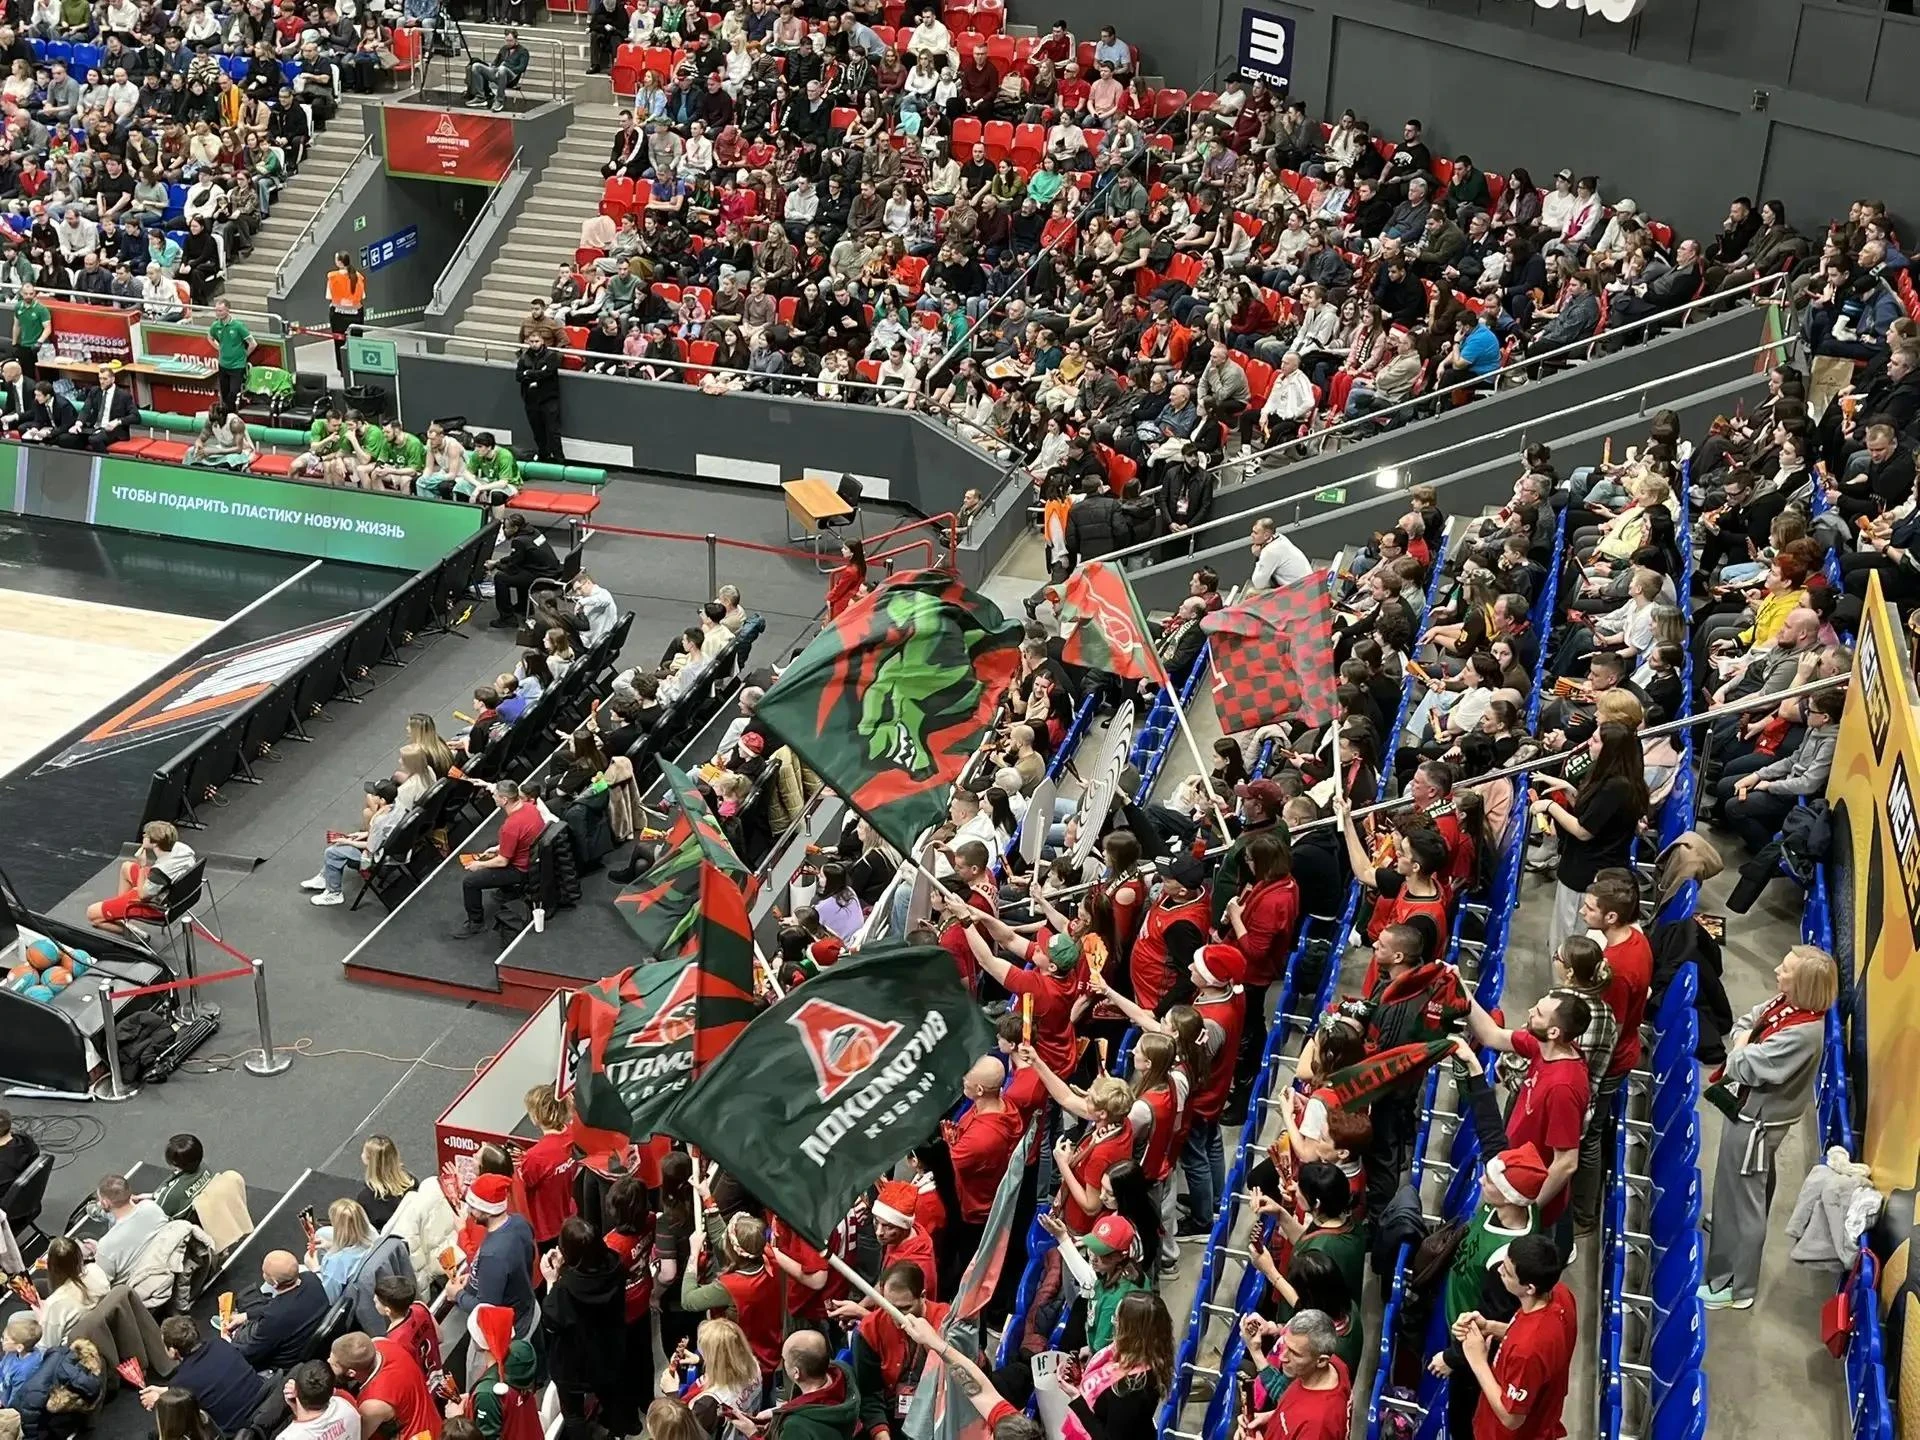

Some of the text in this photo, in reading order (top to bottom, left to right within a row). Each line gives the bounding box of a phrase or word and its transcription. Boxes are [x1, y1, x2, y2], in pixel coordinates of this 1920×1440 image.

[1240, 66, 1288, 87] СЕКТОР
[382, 241, 394, 261] 2
[112, 485, 405, 539] ЧТОБЫ ПОДАРИТЬ ПЛАСТИКУ НОВУЮ ЖИЗНЬ
[799, 1010, 948, 1168] ЛОКОМОТИВ
[443, 1135, 480, 1151] «ЛОКО»
